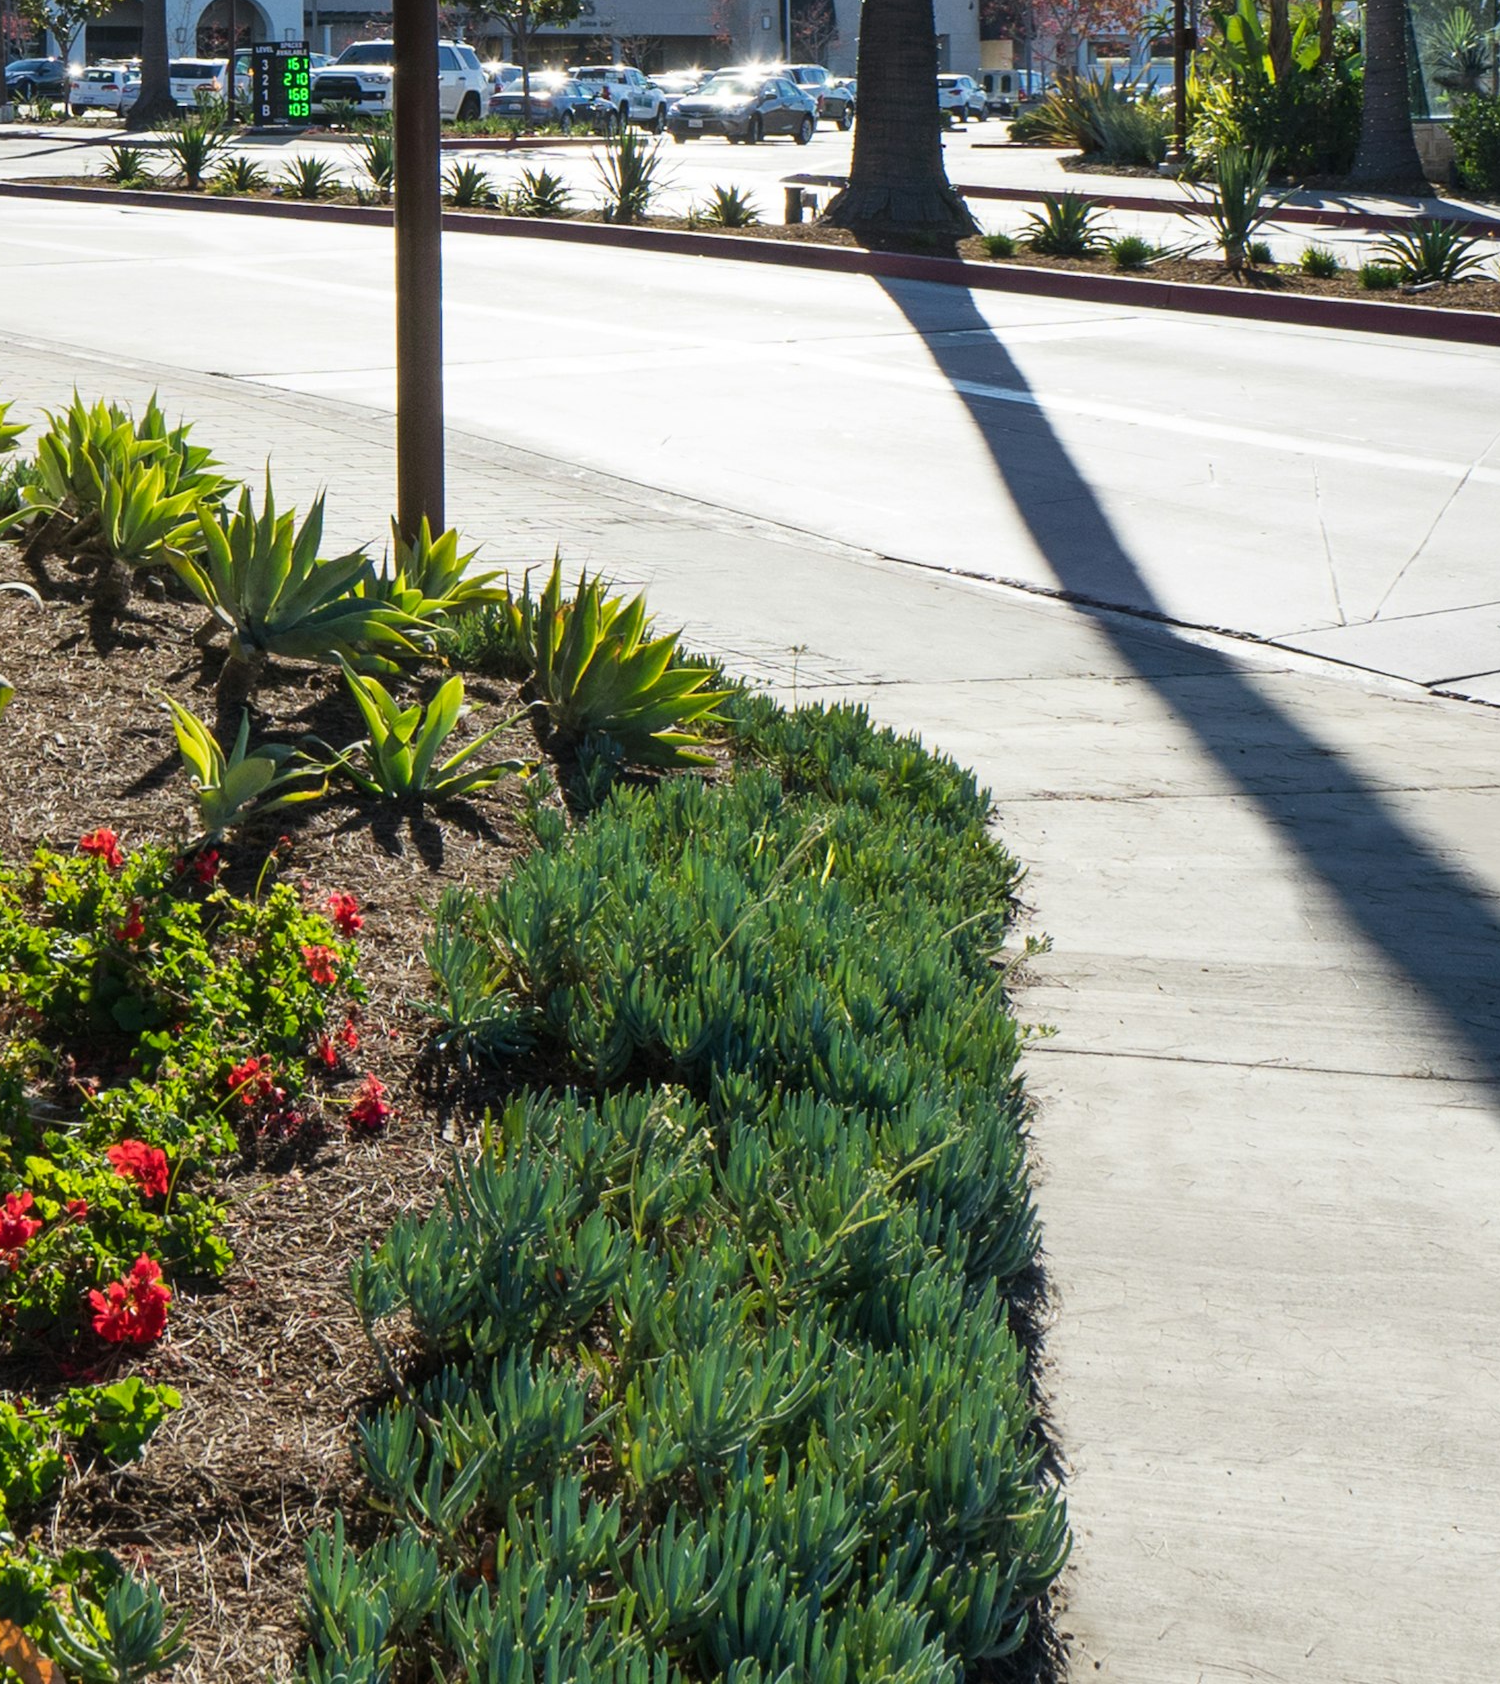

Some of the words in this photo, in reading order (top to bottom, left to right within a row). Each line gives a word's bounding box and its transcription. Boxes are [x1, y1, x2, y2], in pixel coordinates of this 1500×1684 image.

[255, 45, 274, 54] LEVEL
[262, 59, 269, 70] 3
[262, 74, 269, 86] 2
[283, 72, 309, 86] 210
[262, 89, 268, 101] 1
[288, 87, 309, 101] 168
[262, 104, 270, 116] B
[288, 102, 309, 117] 103
